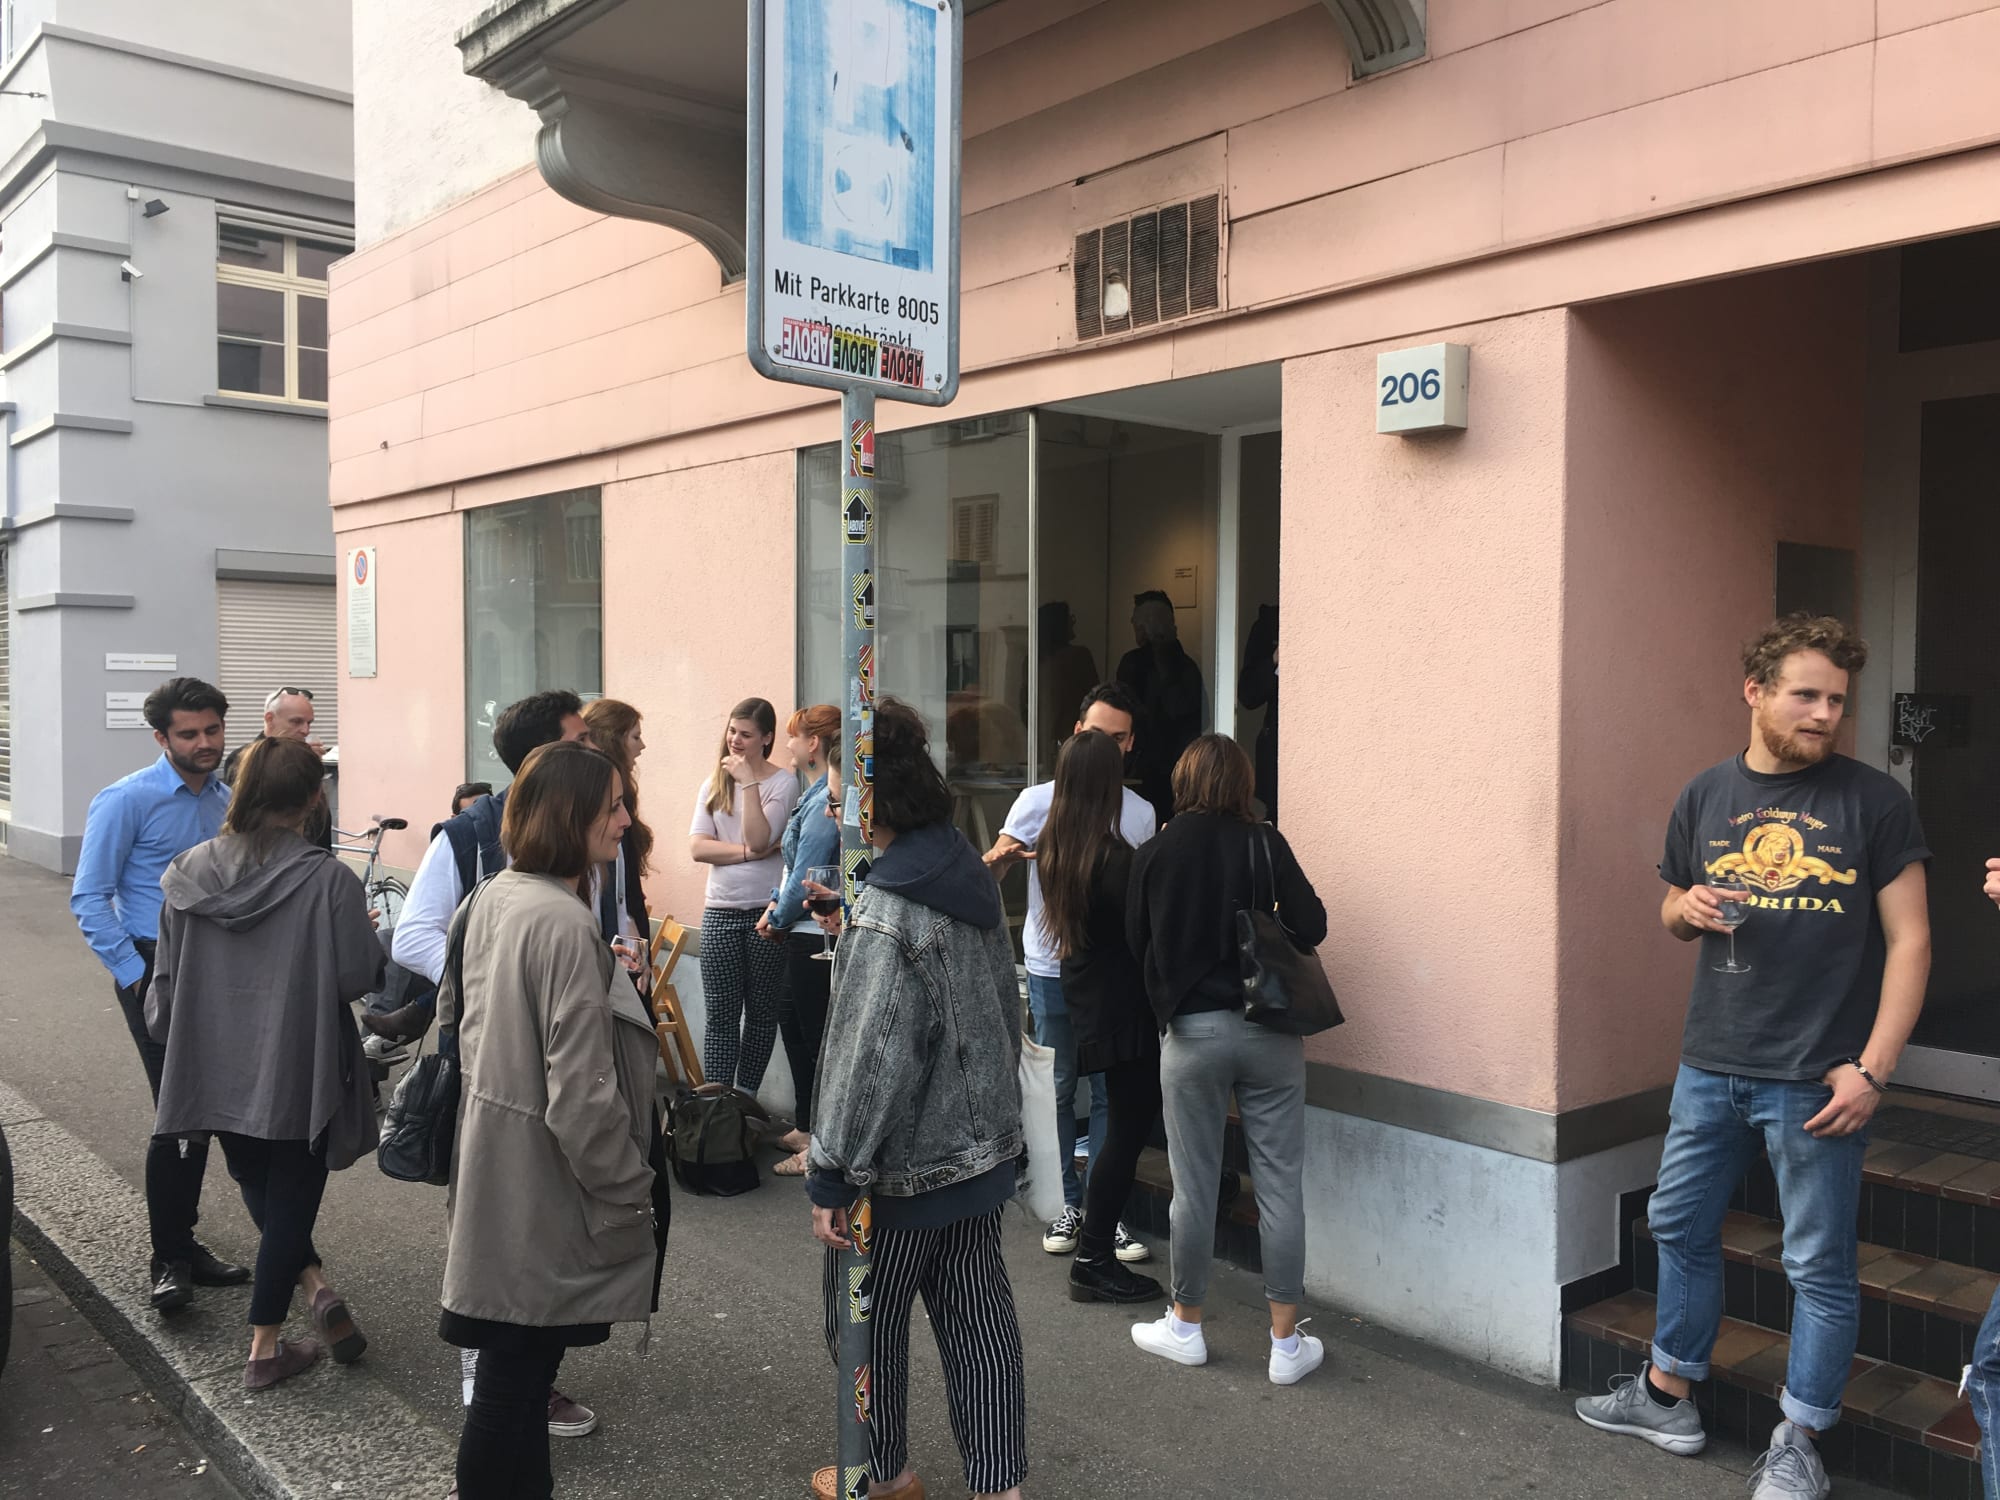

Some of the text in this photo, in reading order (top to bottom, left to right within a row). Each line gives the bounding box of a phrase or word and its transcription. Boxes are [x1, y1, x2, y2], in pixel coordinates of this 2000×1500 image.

[774, 269, 939, 325] Mit Parkkarte 8005
[784, 323, 830, 365] ABOVE
[833, 337, 877, 377] ABOVE
[881, 346, 923, 387] ABOVE
[1381, 368, 1440, 406] 206
[848, 519, 865, 532] ABOVE
[1728, 807, 1829, 830] Metro Goldwyn Mayer
[1708, 840, 1731, 848] TRADE
[1817, 844, 1842, 854] MARK
